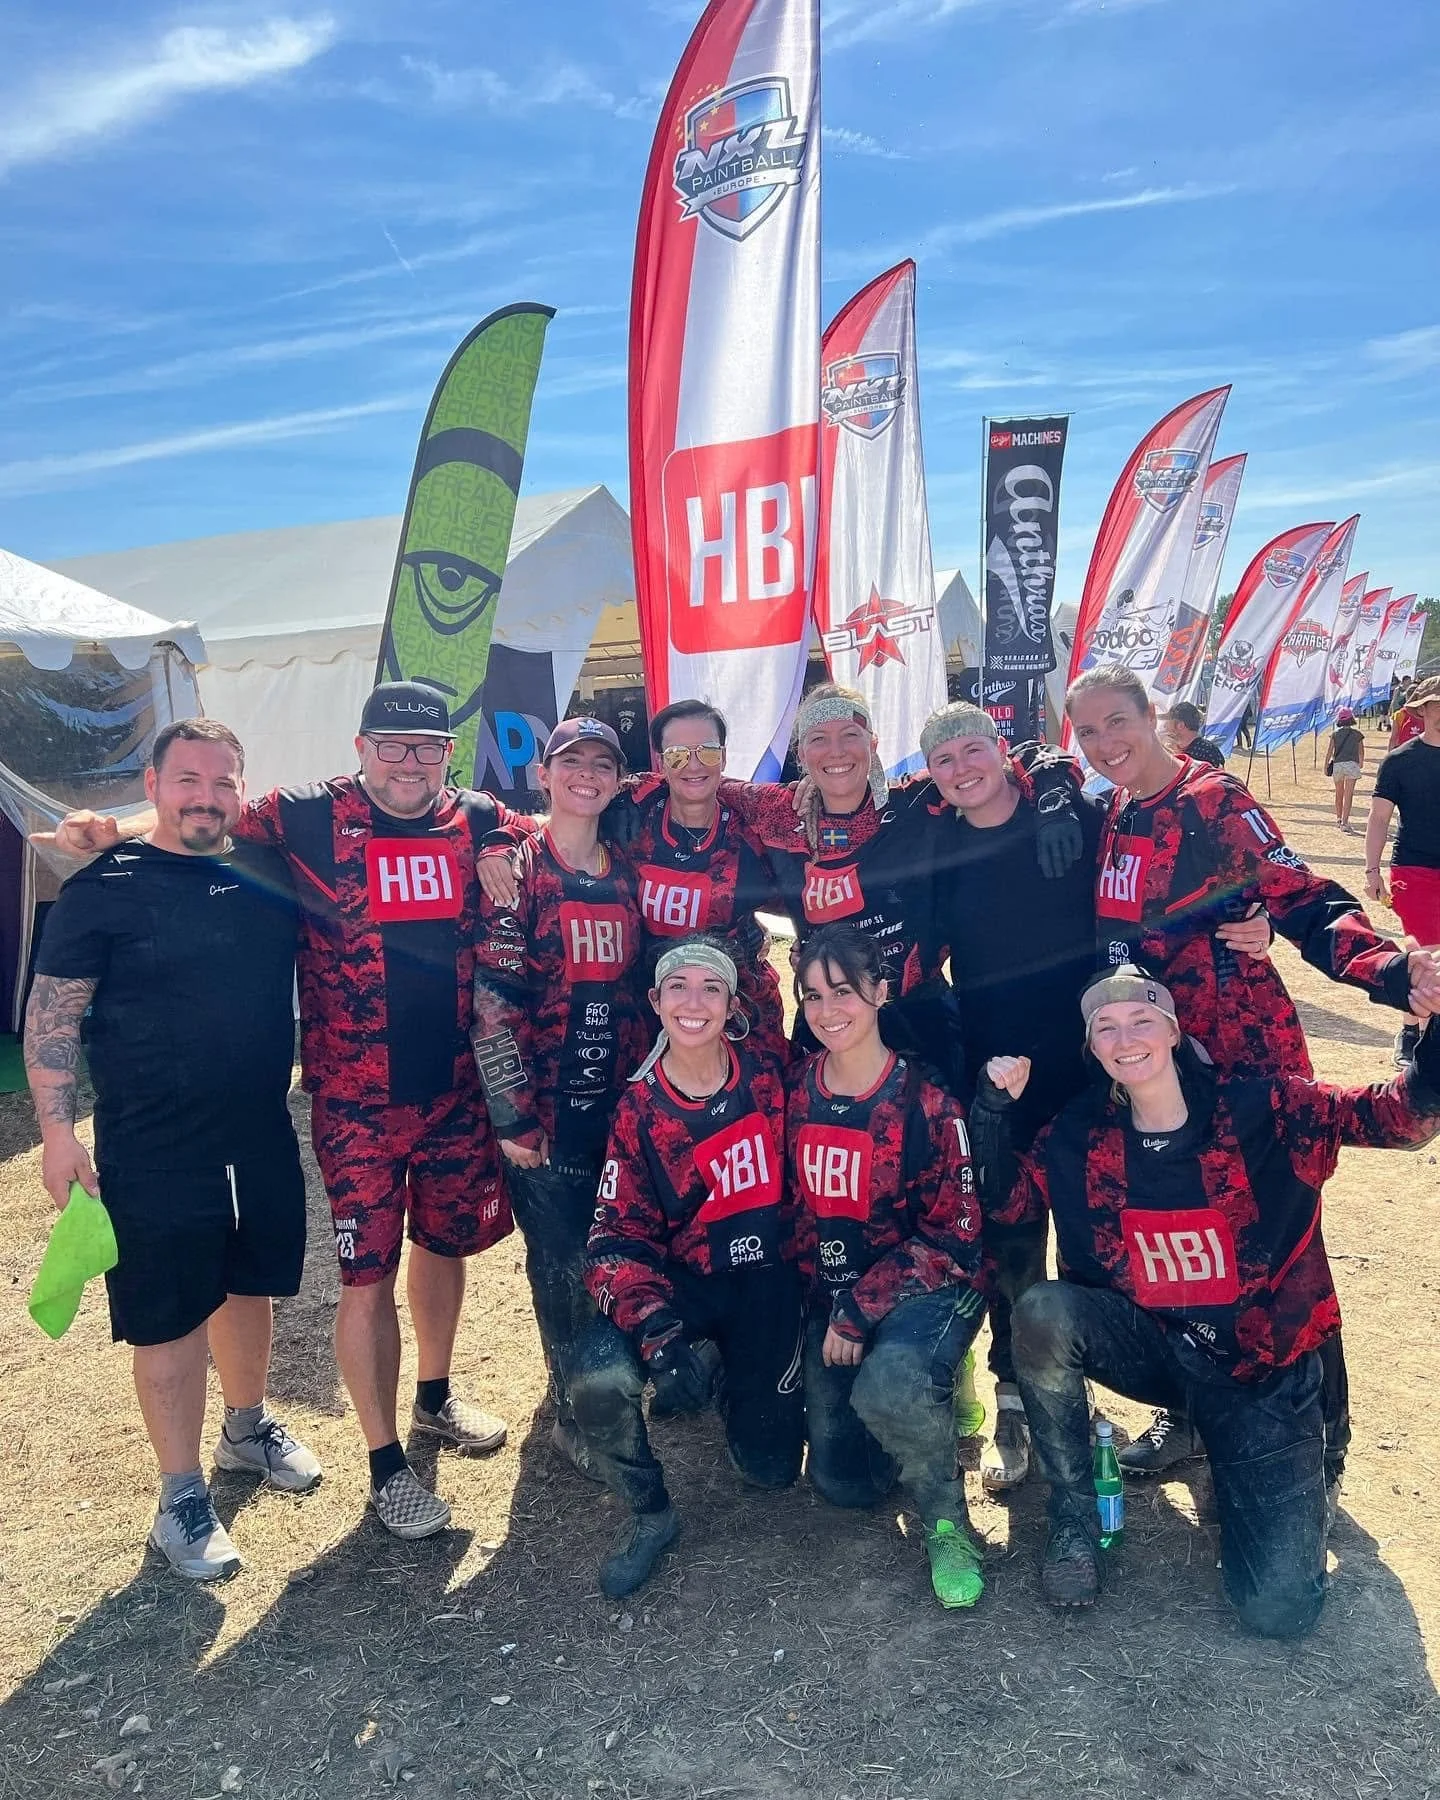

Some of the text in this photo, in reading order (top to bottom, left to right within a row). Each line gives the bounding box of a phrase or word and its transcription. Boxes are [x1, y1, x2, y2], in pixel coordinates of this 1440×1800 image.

[680, 116, 807, 180] NXL
[692, 151, 794, 191] PAINTBALL
[716, 175, 761, 195] EUROPE
[1012, 430, 1062, 446] MACHINES
[686, 474, 816, 608] HBI
[821, 606, 934, 654] BLAST
[1281, 632, 1332, 652] CARNAGE
[378, 855, 453, 903] HBI
[806, 874, 854, 911] HBI
[1099, 851, 1142, 903] HBI
[642, 879, 702, 928] HBI
[570, 919, 624, 964] HBI
[1109, 942, 1129, 957] PRO
[585, 1003, 609, 1017] PRO
[585, 1016, 609, 1025] SHAR
[474, 1029, 529, 1097] HBI
[803, 1143, 861, 1202] HBI
[483, 1199, 499, 1221] HB
[730, 1235, 762, 1257] PRO
[732, 1250, 764, 1266] SHAR
[1134, 1228, 1225, 1283] HBI
